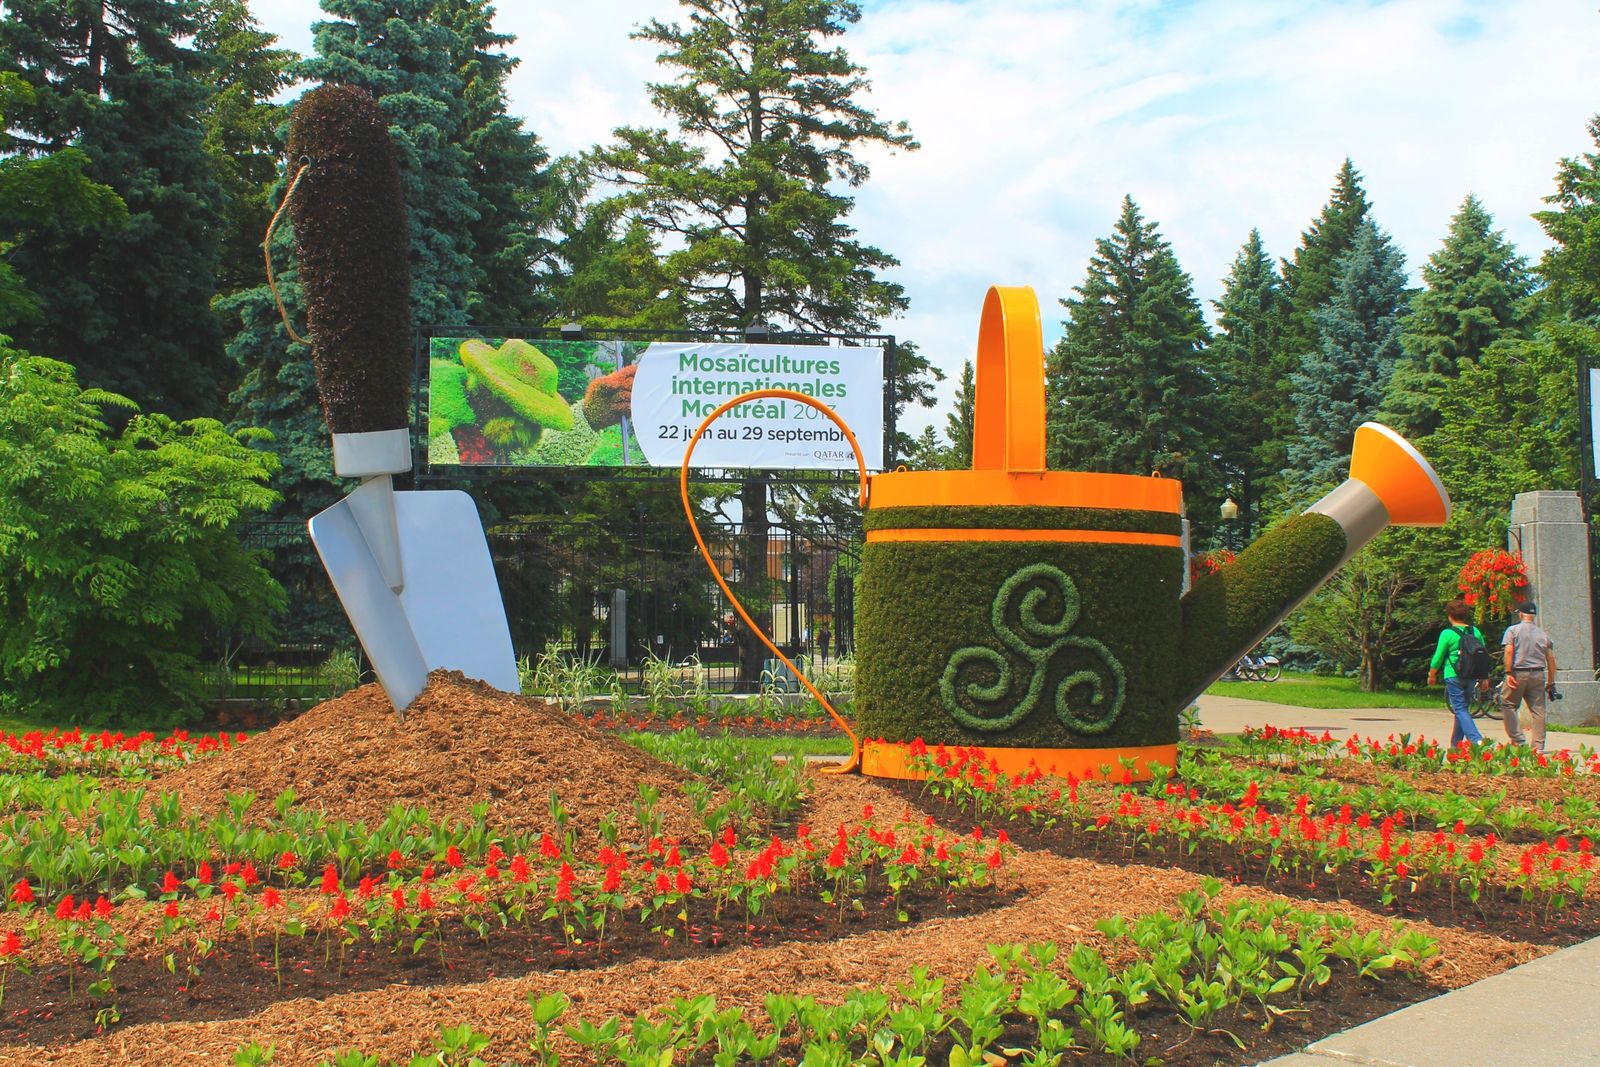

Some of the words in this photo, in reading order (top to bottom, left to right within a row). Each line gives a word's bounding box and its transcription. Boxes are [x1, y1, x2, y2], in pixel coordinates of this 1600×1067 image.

[679, 353, 840, 374] Mosaïcultures
[672, 376, 847, 398] internationales
[658, 425, 679, 439] 22
[683, 425, 712, 442] jun
[717, 429, 737, 440] au
[742, 426, 763, 440] 29
[768, 427, 856, 443] septembr
[814, 450, 844, 459] QATAR
